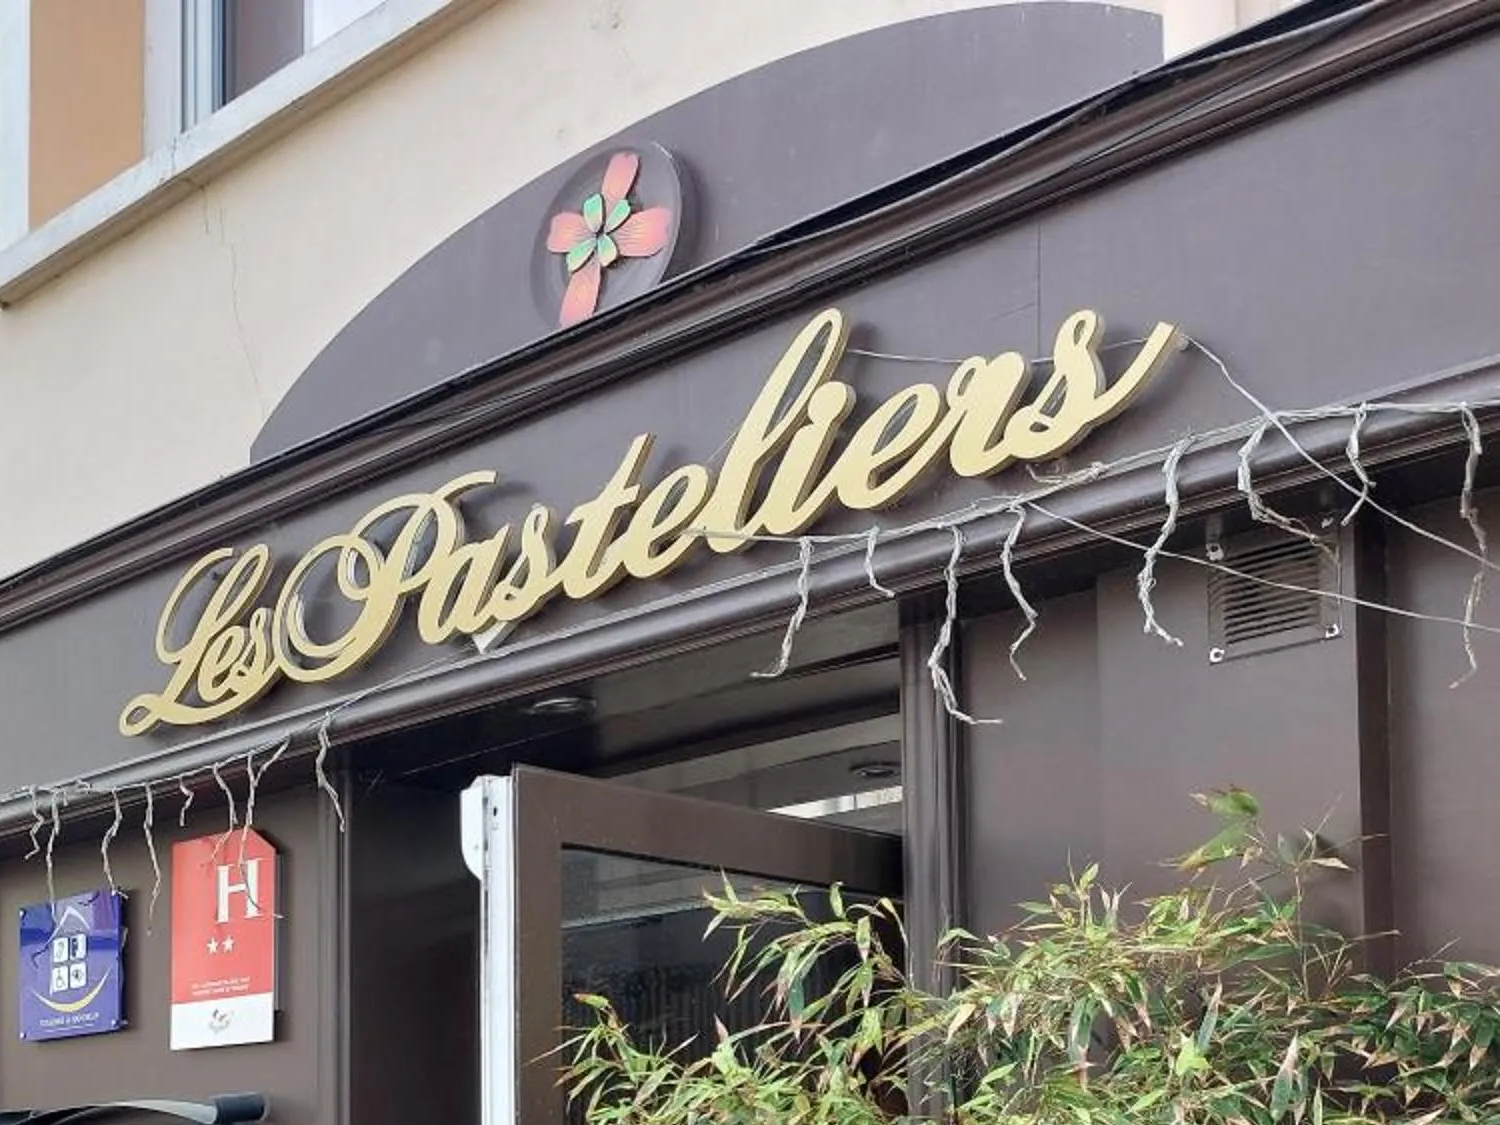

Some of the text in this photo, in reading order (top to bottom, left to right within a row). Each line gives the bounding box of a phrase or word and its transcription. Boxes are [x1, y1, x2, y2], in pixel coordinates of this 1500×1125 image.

[118, 306, 1186, 737] Les Pasteliers
[215, 857, 261, 924] H
